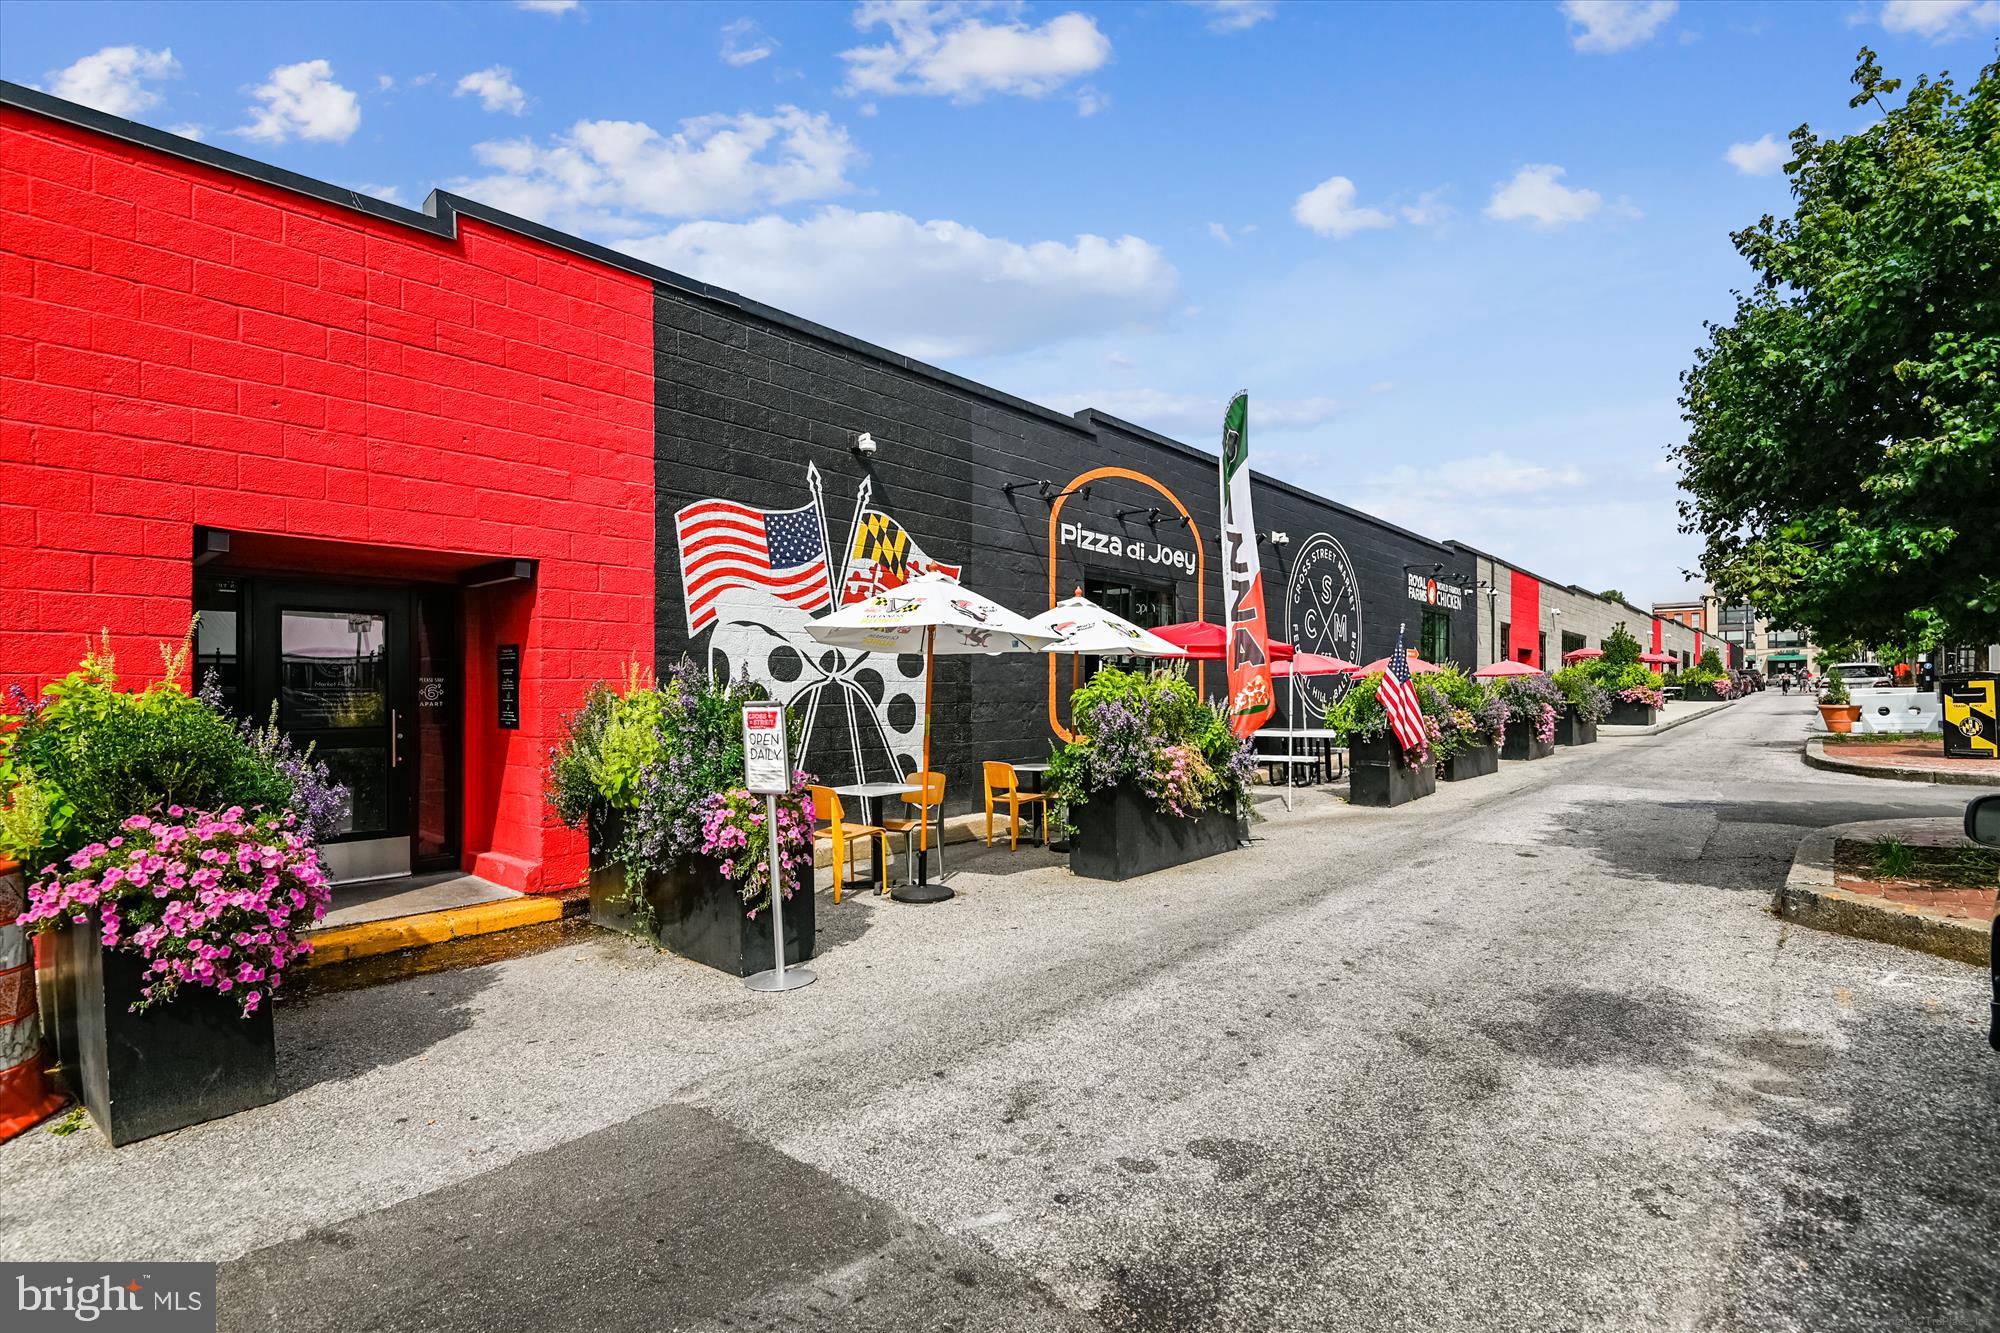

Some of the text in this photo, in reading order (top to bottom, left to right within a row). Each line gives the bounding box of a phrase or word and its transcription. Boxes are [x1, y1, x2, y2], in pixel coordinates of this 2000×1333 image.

[1061, 522, 1196, 575] Pizza di Joey
[1294, 548, 1355, 611] CROSS STREET MARKET
[1321, 575, 1332, 604] S
[1408, 573, 1427, 589] ROYAL
[1408, 586, 1427, 602] FARMS
[1436, 591, 1461, 610] CHICKEN
[1305, 608, 1347, 642] C M
[1312, 687, 1327, 703] HILL
[1333, 631, 1356, 698] BALTORE
[749, 732, 780, 745] OPEN
[750, 747, 782, 760] DAILY
